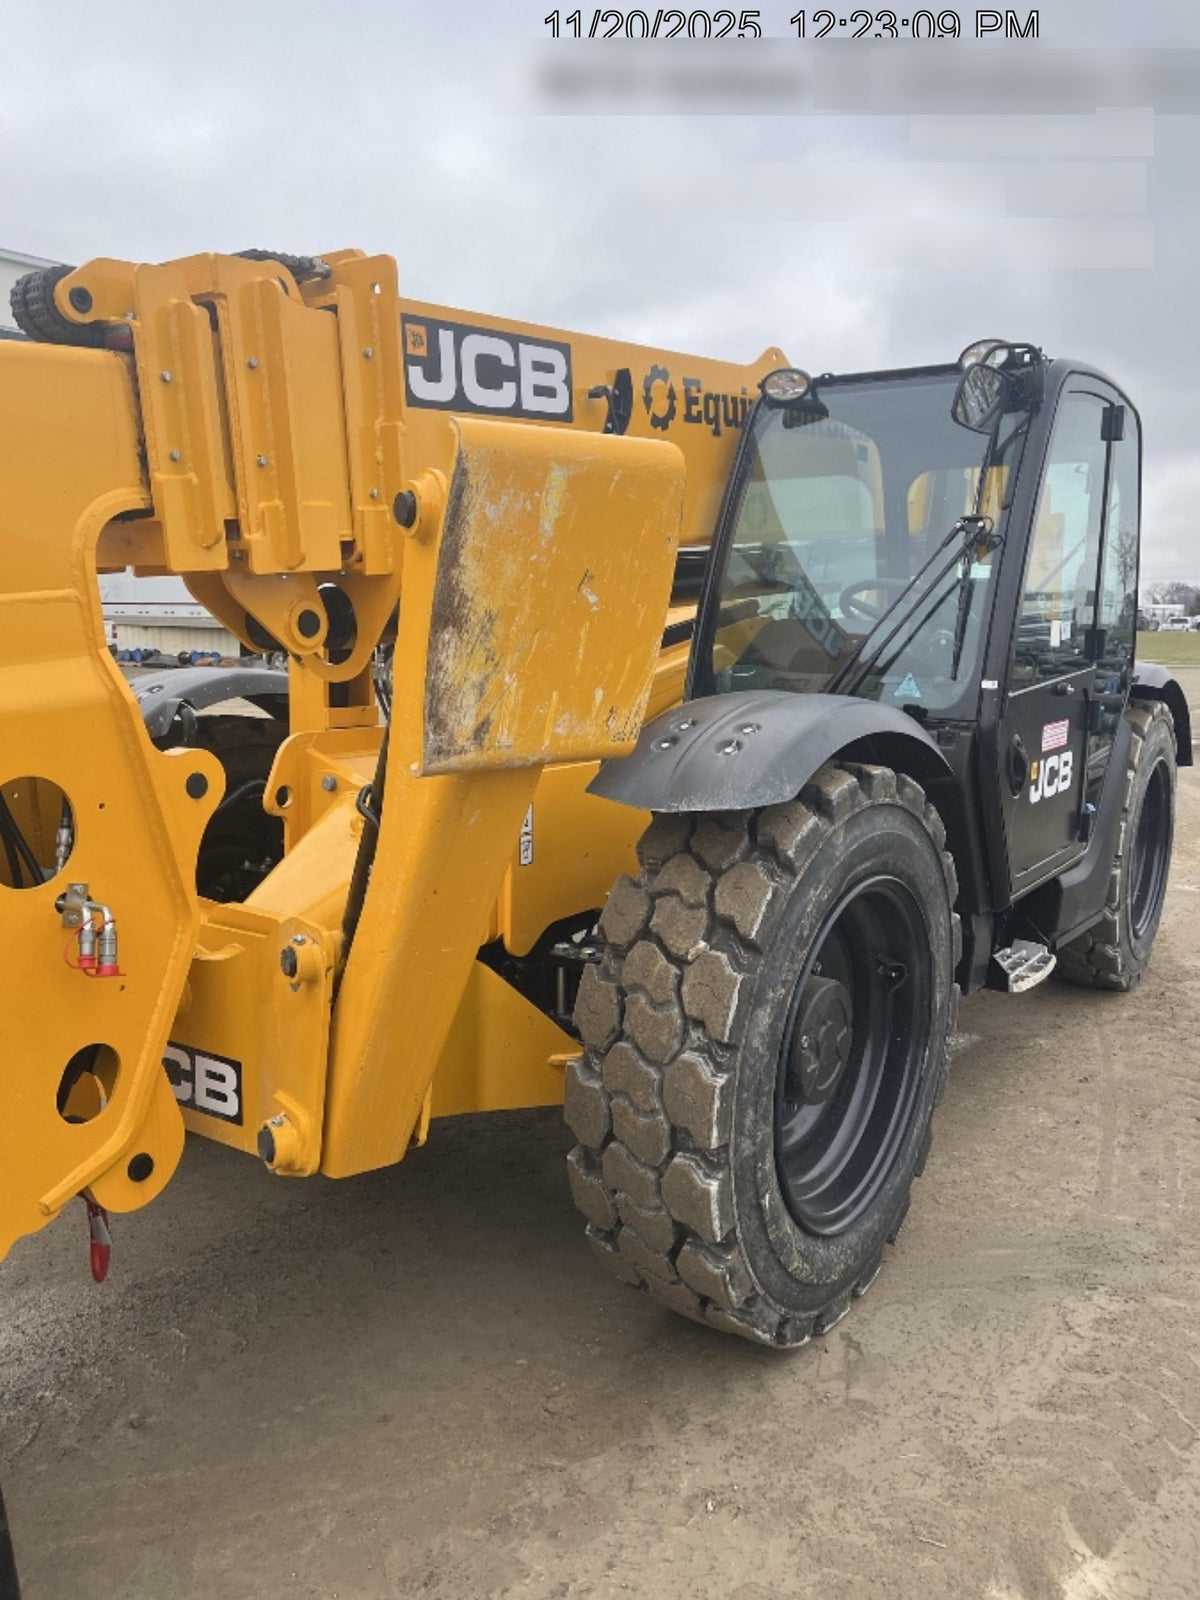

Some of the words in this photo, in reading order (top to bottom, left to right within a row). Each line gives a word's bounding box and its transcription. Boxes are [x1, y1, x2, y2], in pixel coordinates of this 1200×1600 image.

[407, 328, 570, 413] JCB
[683, 377, 752, 437] Equi
[1029, 750, 1073, 805] JCB
[163, 1046, 239, 1117] CB
